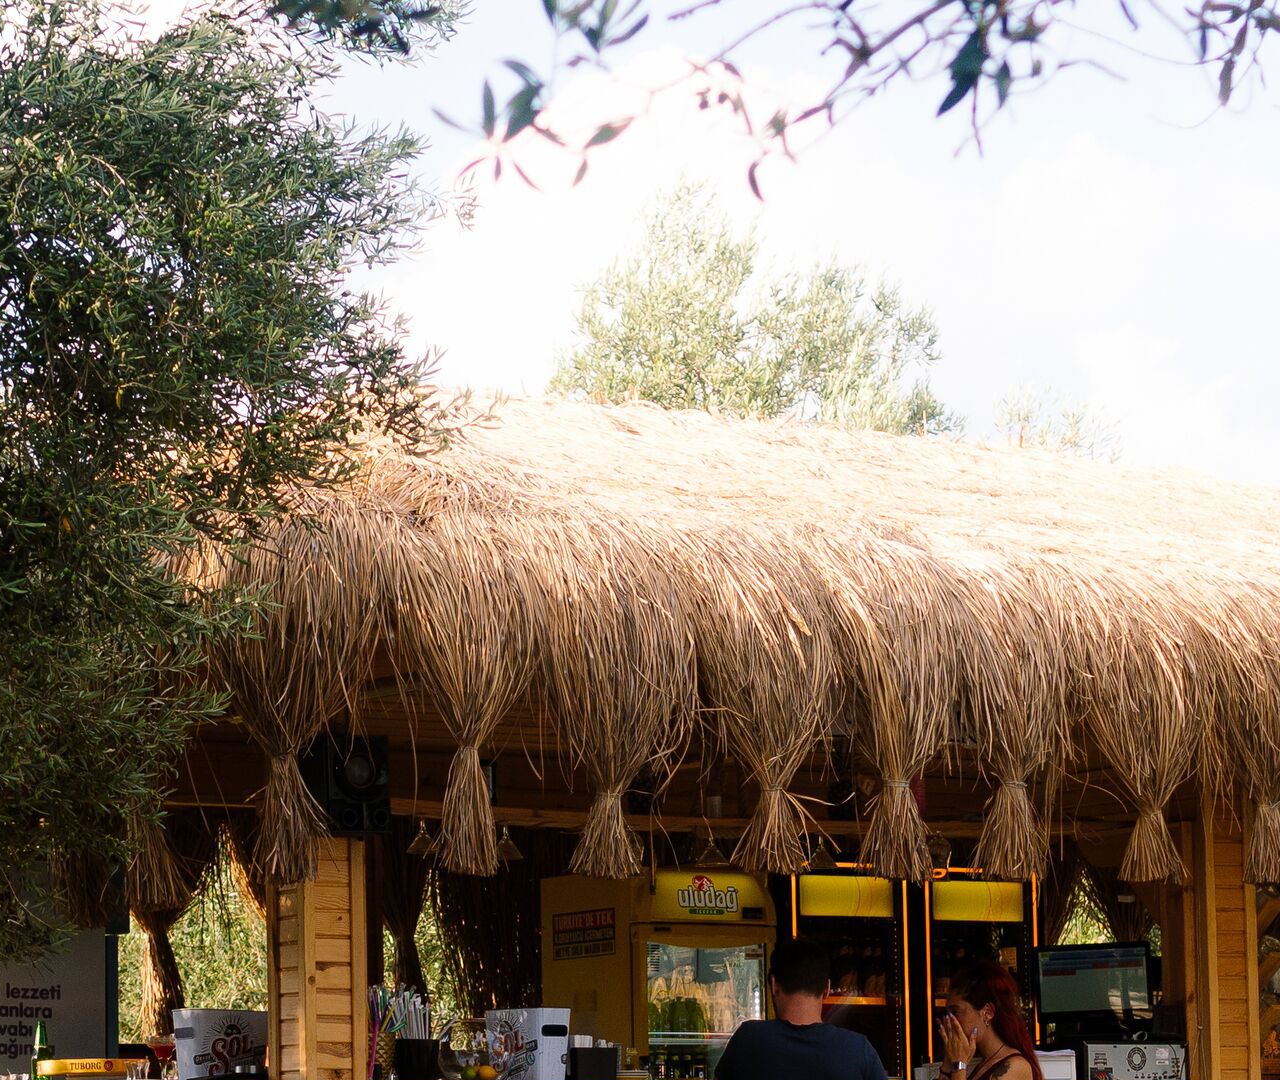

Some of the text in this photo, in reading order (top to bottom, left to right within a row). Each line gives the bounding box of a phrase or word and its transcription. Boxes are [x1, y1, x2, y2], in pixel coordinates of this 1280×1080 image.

[678, 884, 738, 913] uludağ
[6, 983, 62, 1000] lezzeti
[70, 1062, 101, 1071] TUBORG
